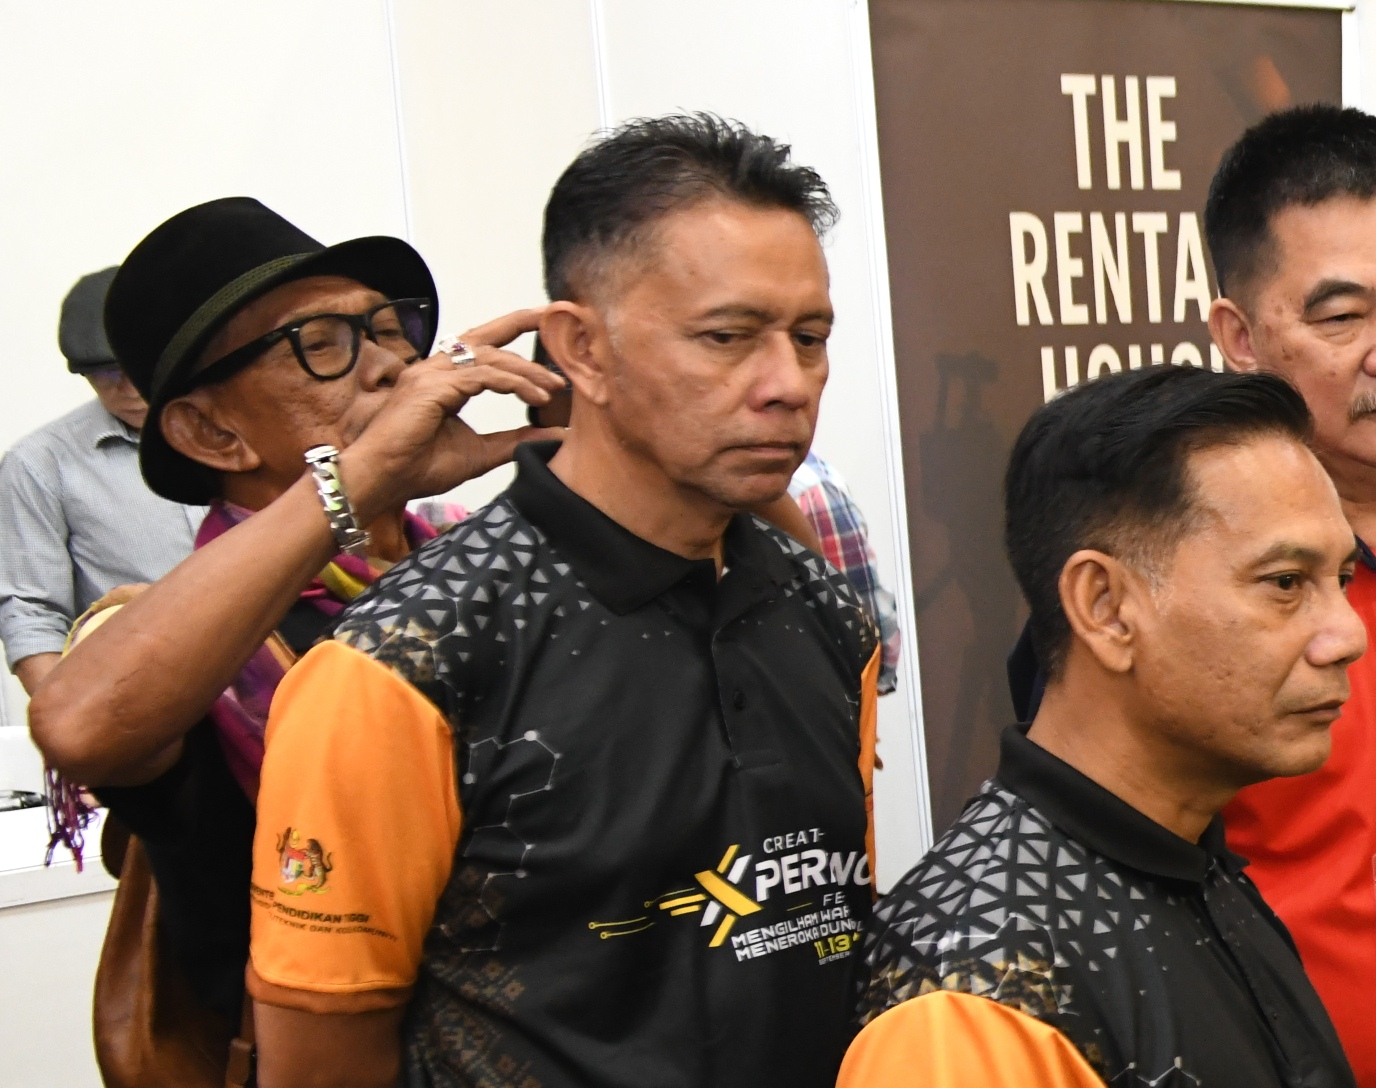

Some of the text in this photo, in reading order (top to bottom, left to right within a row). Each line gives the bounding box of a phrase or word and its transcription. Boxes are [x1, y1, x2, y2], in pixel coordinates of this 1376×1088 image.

[1061, 73, 1181, 190] THE
[1009, 211, 1222, 325] RENTA
[763, 828, 826, 853] CREAT
[735, 927, 819, 961] MENEROKA
